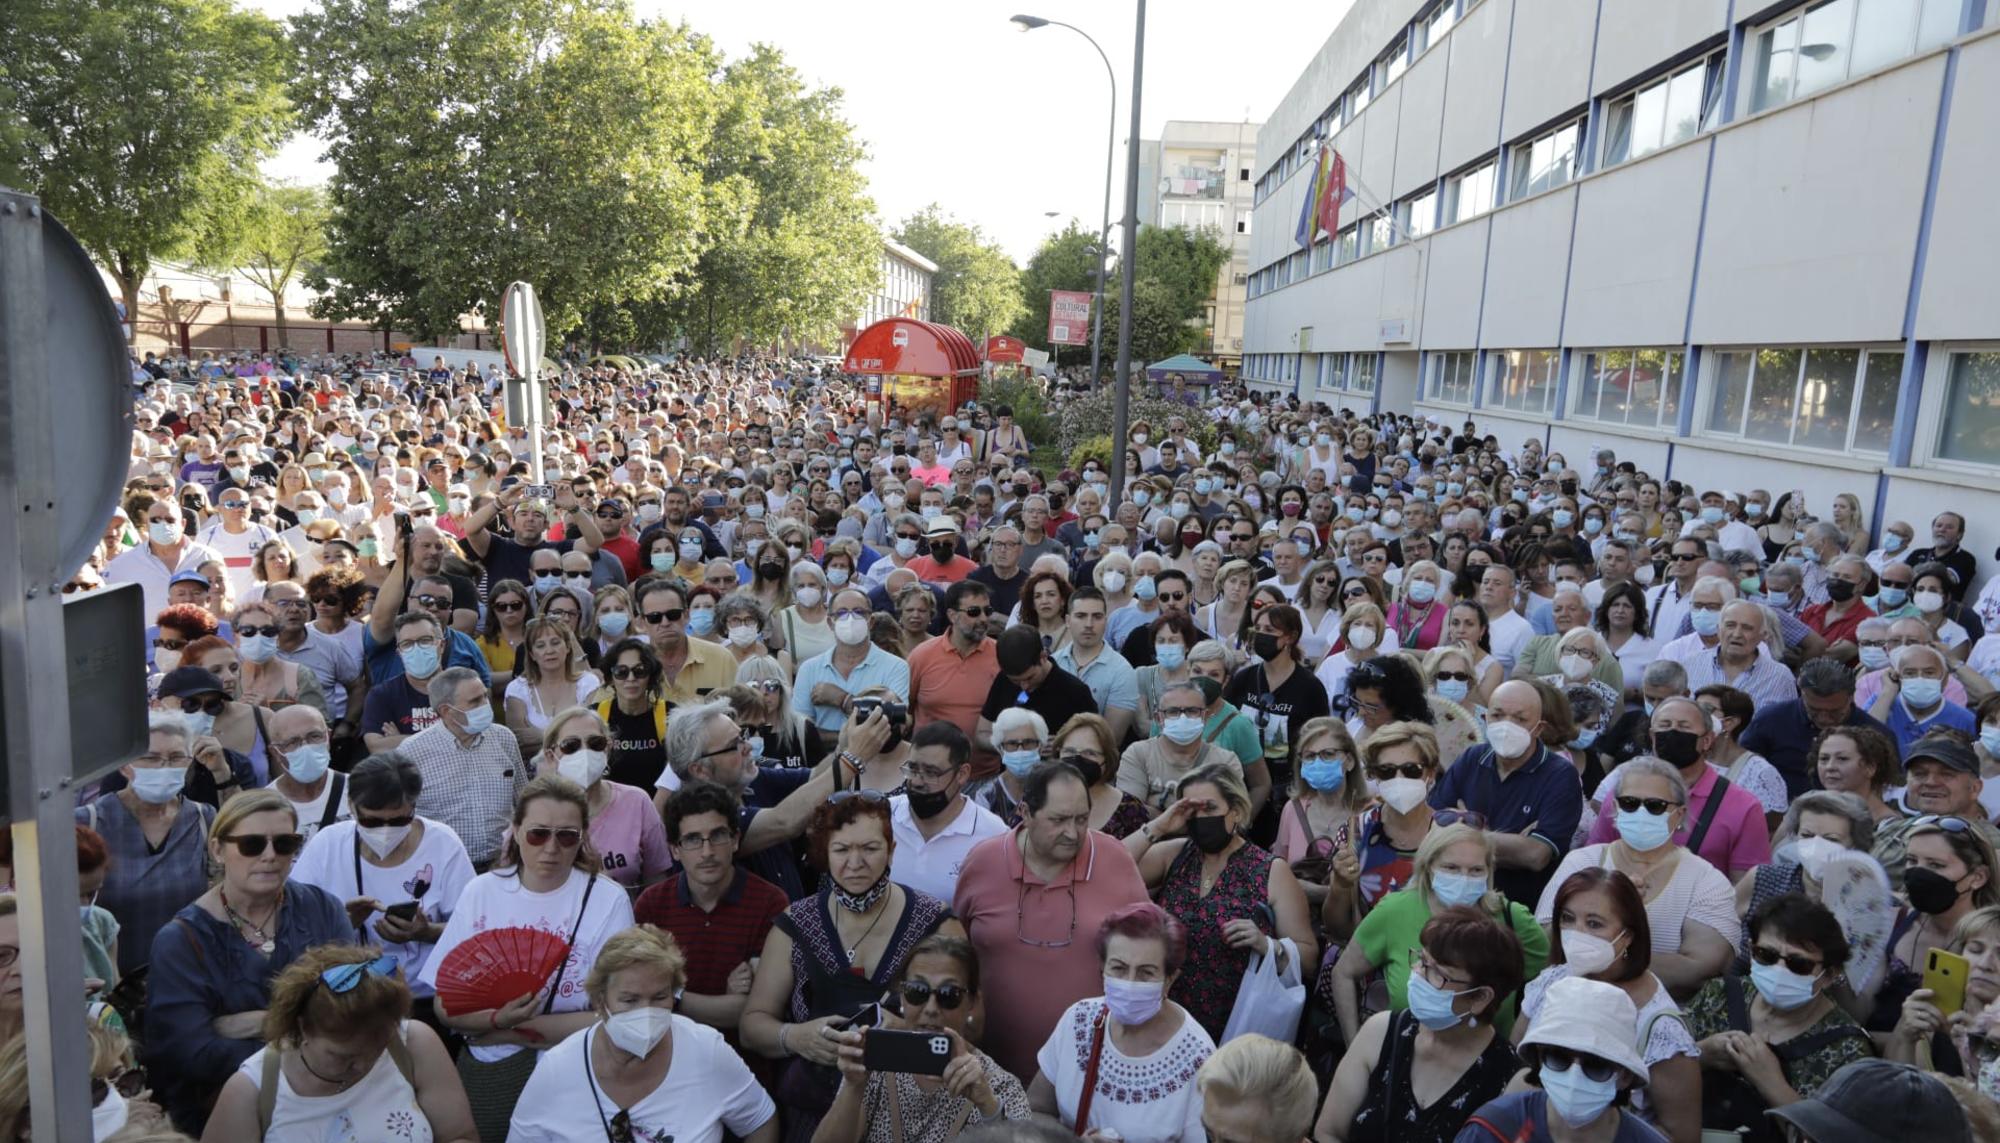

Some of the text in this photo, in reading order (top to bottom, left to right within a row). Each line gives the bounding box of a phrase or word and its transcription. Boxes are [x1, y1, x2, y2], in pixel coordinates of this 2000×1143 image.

[1055, 302, 1088, 313] CULTURAL
[1247, 692, 1293, 713] VA OGH
[611, 738, 657, 750] RGULLO
[602, 851, 627, 870] da
